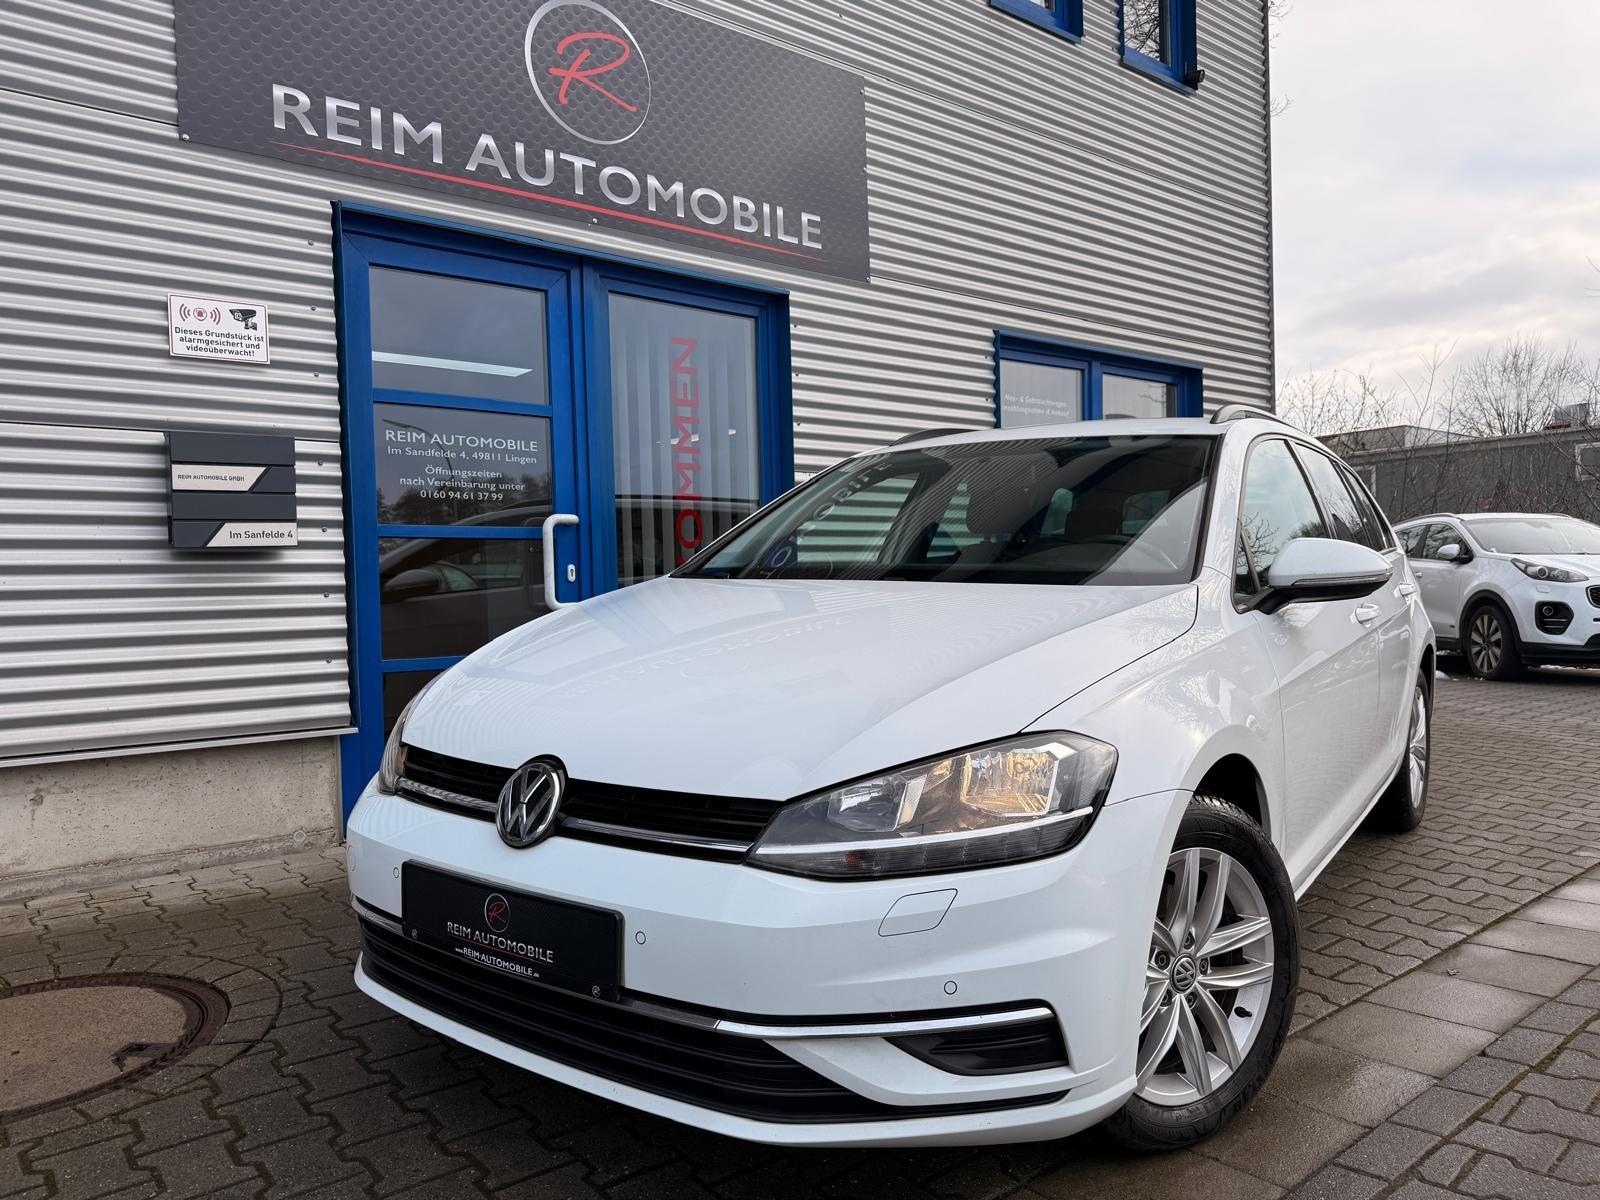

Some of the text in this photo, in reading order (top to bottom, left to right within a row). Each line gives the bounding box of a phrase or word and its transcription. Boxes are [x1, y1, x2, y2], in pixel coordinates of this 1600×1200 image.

[549, 31, 638, 113] R
[271, 83, 823, 250] REIM AUTOMOBILE
[175, 326, 203, 336] Dieses
[204, 329, 253, 341] Grundstück
[179, 336, 260, 350] alarmgesichert und
[186, 344, 255, 356] videoüberwacht!
[385, 429, 538, 452] REIM AUTOMOBILE
[387, 445, 537, 465] Im Sandfelde 4, 49811 Lingen
[671, 335, 704, 567] OMMEN
[425, 464, 503, 479] Öffnungszeiten
[400, 476, 526, 492] nach Vereinbarung unter
[420, 489, 504, 501] 0160 94 61 37 99
[229, 530, 294, 539] Im Sanfelde 4
[489, 901, 506, 924] R
[447, 921, 554, 964] REIM AUTOMOBILE
